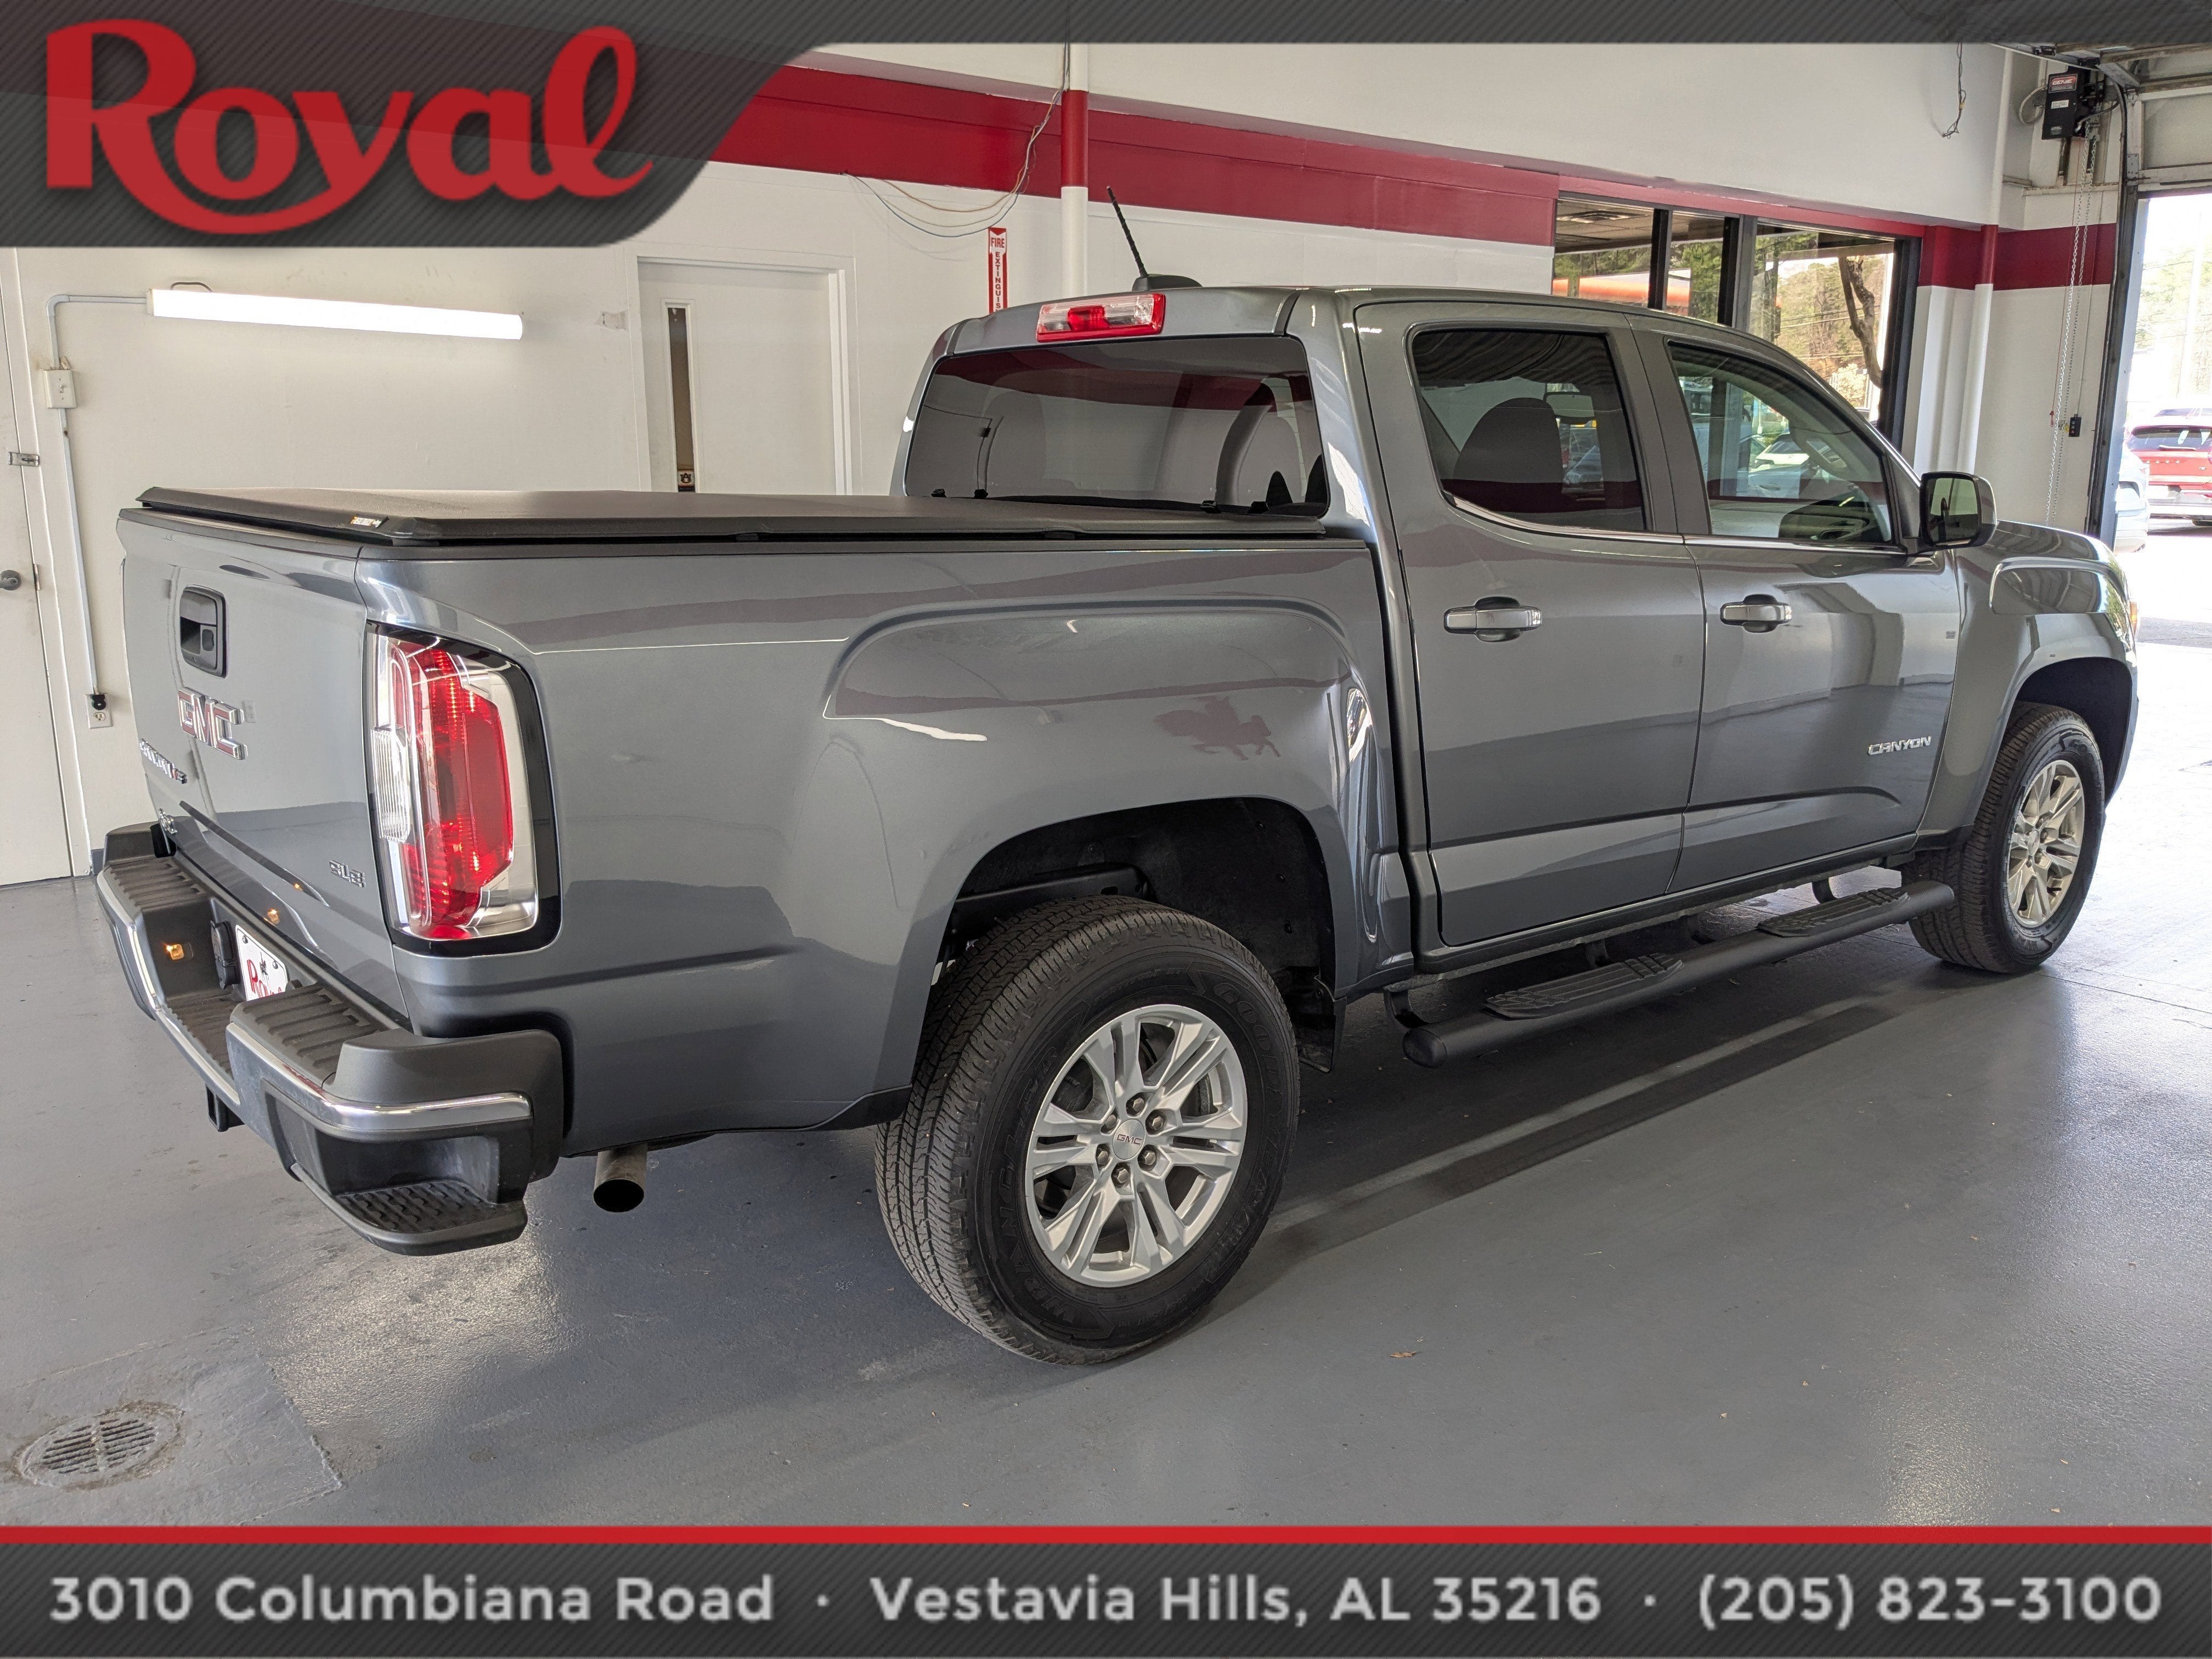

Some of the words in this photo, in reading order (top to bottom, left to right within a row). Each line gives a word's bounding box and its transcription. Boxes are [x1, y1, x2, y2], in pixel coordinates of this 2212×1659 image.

[991, 237, 1005, 248] FIRE
[177, 687, 248, 760] GMC
[1867, 735, 1932, 755] CANYON
[1117, 1133, 1142, 1145] GMC
